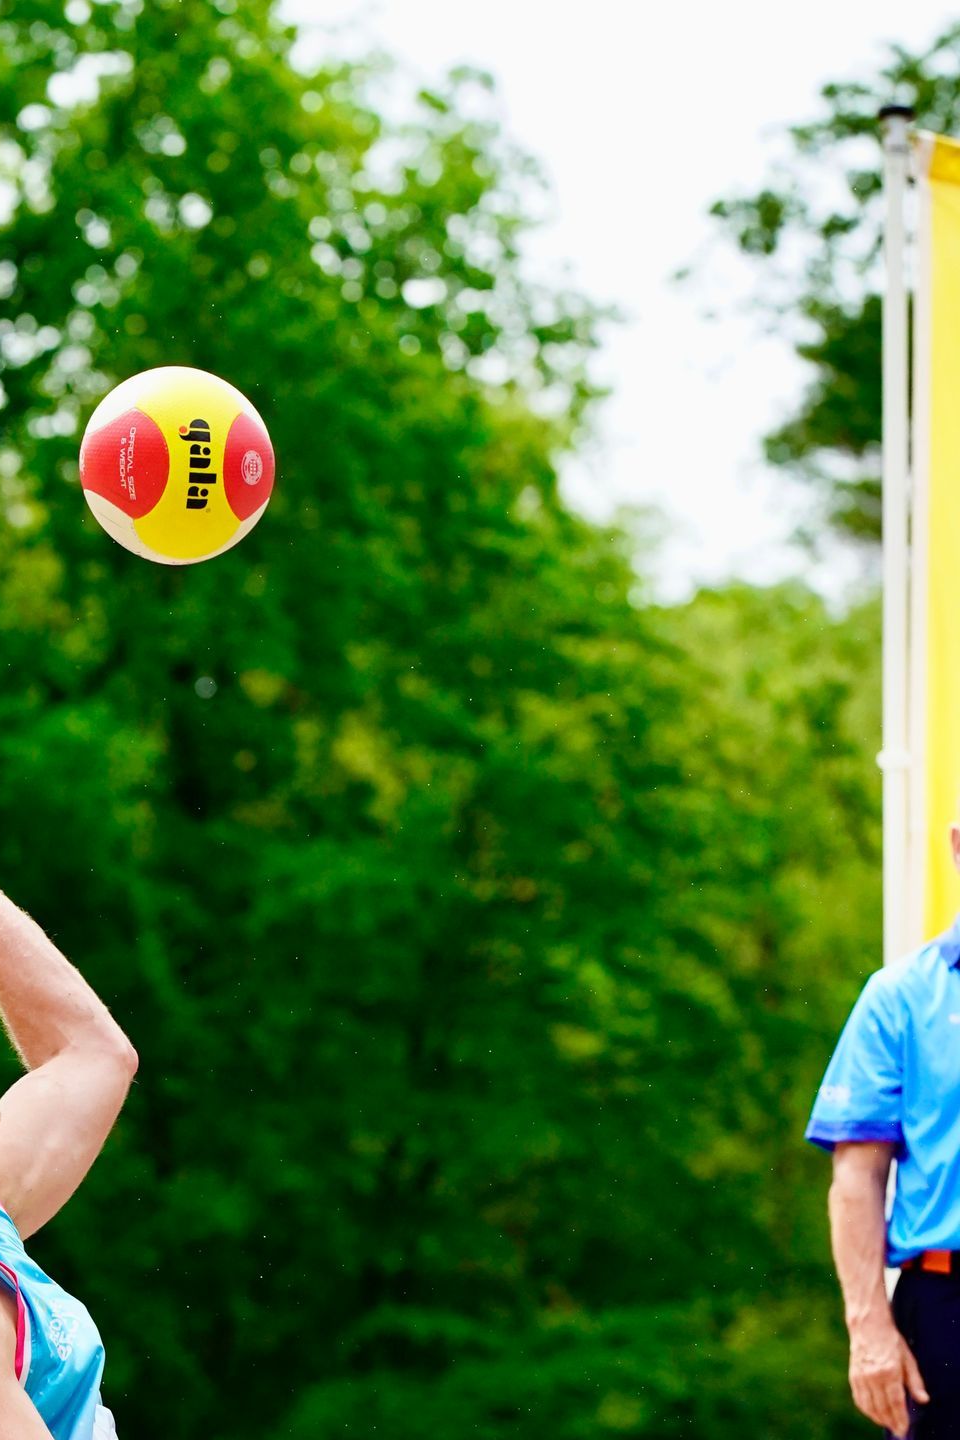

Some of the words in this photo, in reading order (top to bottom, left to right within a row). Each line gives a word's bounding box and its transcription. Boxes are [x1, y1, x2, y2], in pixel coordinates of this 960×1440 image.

[119, 448, 127, 489] WEIGHT
[179, 418, 217, 510] gala
[127, 475, 137, 501] SIZE
